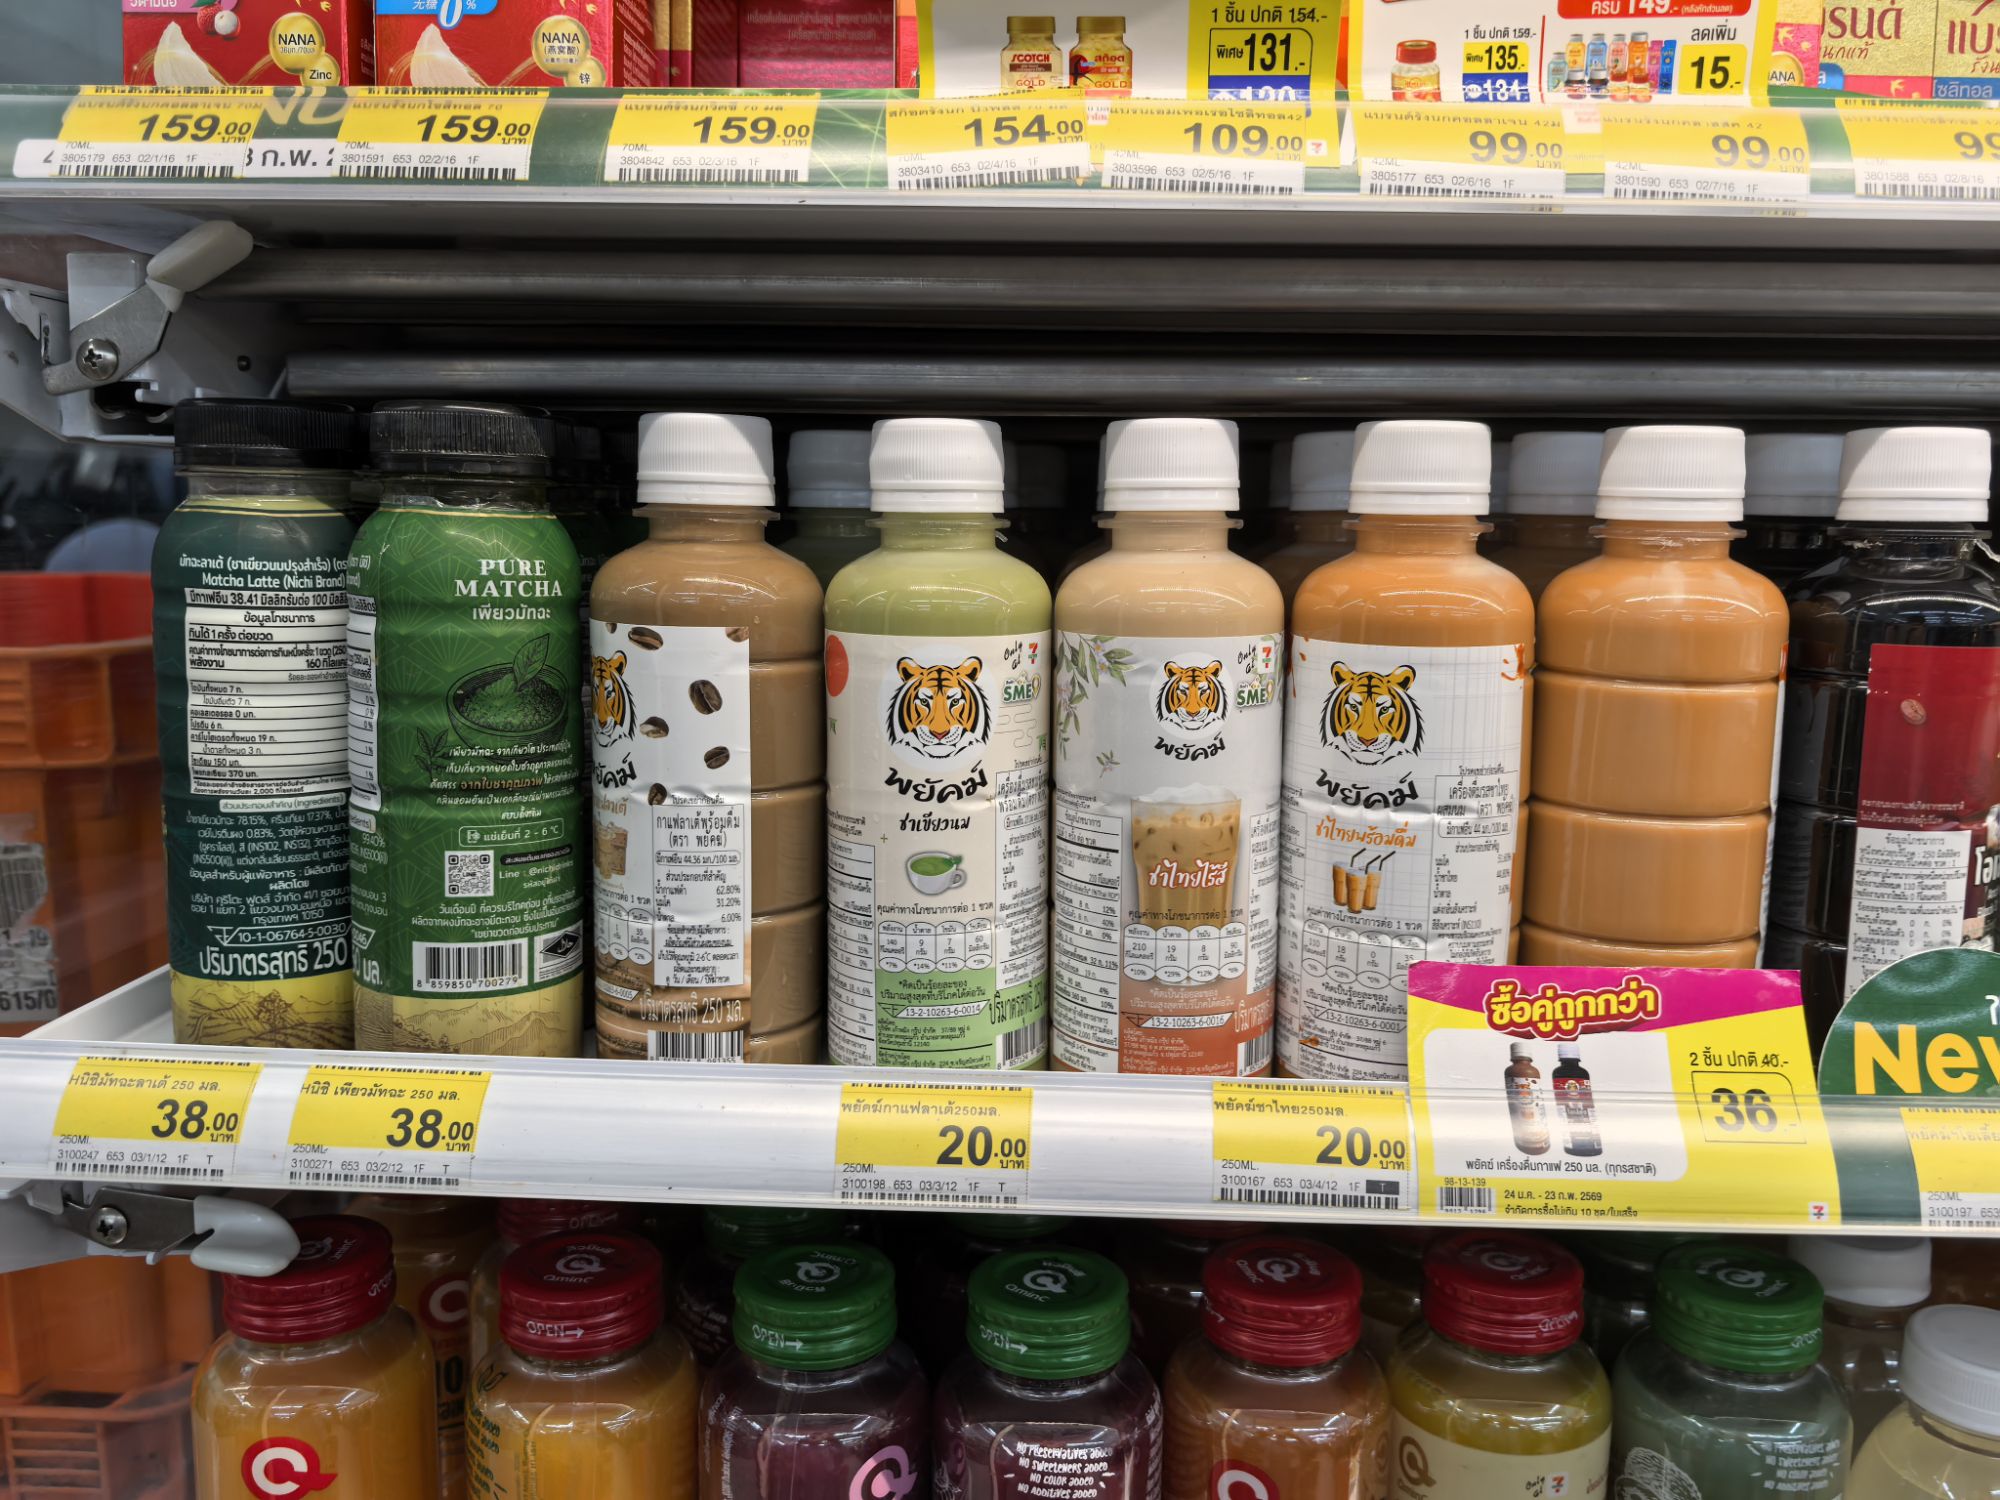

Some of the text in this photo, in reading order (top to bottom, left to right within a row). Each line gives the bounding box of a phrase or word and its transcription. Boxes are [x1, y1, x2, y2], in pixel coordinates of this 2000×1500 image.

[1225, 2, 1244, 23] ชิ้น
[1250, 5, 1282, 23] ปกติ
[1472, 25, 1510, 40] ชิ้น ปกติ
[1690, 19, 1737, 41] ลดเพิ่ม
[278, 34, 316, 46] NANA
[542, 33, 580, 44] NANA
[1011, 53, 1050, 62] SCOTCH
[1216, 44, 1243, 59] พิเศษ
[309, 70, 332, 80] Zinc
[1016, 79, 1045, 87] GOLD
[1094, 80, 1128, 88] GOLD
[138, 113, 252, 142] 159.00
[416, 115, 531, 143] 159.00
[693, 116, 810, 144] 159.00
[964, 113, 1083, 147] 154.00
[1183, 123, 1303, 157] 109.00
[1469, 131, 1563, 164] 99.00
[61, 154, 175, 163] 3805179 653 02/1/16
[261, 148, 317, 167] ก.พ.
[1711, 134, 1805, 168] 99.00
[341, 154, 456, 165] 3801591 653 02/2/16
[620, 156, 737, 166] 3804842 653 02/3/16
[898, 158, 1017, 177] 3803410 653 02/4/16
[1112, 163, 1231, 180] 3803596 653 02/5/16
[1371, 171, 1491, 188] 3805177 653 02/6/16
[1864, 170, 1984, 184] 3801588 653 02/8/16
[1615, 175, 1735, 192] 3801590 653 02/7/16
[479, 559, 547, 576] PURE
[202, 572, 346, 590] Matcha Latte (Nichi Brand)
[454, 579, 563, 598] MATCHA
[230, 592, 258, 605] 38.41
[312, 593, 328, 606] 100
[243, 610, 316, 626] ข้อมูลโภชนาการ
[472, 603, 552, 620] เพียวมัทฉะ
[218, 625, 237, 640] ครั้ง
[306, 658, 321, 669] 160
[1003, 686, 1033, 702] SME
[1236, 687, 1267, 706] SME
[1154, 731, 1226, 762] พยัคฆ์
[213, 756, 228, 767] 150
[228, 766, 244, 777] 370
[884, 760, 988, 804] พยัคฆ์
[1315, 768, 1419, 810] พยัคฆ์
[656, 806, 740, 831] กาแฟลาเต้พร้อมดื่ม
[899, 811, 971, 832] ชาเขียวนม
[484, 826, 548, 842] แช่เย็นที่ 2 6
[1315, 815, 1417, 847] ชาไทยพร้อมดื่ม
[669, 833, 689, 848] (ตรา
[683, 855, 701, 865] 44.36
[499, 869, 520, 879] Line
[1149, 858, 1229, 889] ชาไทยไร้สี
[269, 879, 310, 891] ผลิตโดย
[716, 885, 741, 895] 62.80%
[716, 898, 741, 908] 31.20%
[877, 903, 969, 916] คุณค่าทางโภชนาการต่อ
[721, 913, 742, 923] 6.00%
[238, 922, 346, 943] 10-1-06764-5-0030
[1132, 942, 1177, 954] 210 19
[199, 937, 348, 979] ปริมาตรสุทธิ 250
[430, 977, 519, 989] 859850 700279
[640, 991, 699, 1033] ปริมาตรสุทธิ
[701, 997, 723, 1024] 250
[726, 996, 745, 1023] มล.
[1489, 980, 1655, 1033] ซื้อคู่ถูกกว่า
[1325, 1011, 1400, 1032] 13-2-10263-6-0001
[1689, 1047, 1758, 1068] 2 ชิ้น ปกติ
[171, 1080, 194, 1091] 250
[334, 1082, 406, 1099] เพียวมัทฉะ
[410, 1089, 433, 1100] 250
[151, 1098, 239, 1139] 38.00
[386, 1107, 475, 1149] 38.00
[210, 1132, 234, 1143] บาท
[936, 1124, 1027, 1166] 20.00
[446, 1141, 470, 1152] บาท
[1316, 1125, 1406, 1167] 20.00
[57, 1149, 168, 1163] 3100247 653 03/1/12
[999, 1158, 1025, 1169] บาท
[290, 1158, 403, 1173] 3100271 653 03/2/12
[1221, 1158, 1260, 1171] 250ML.
[1379, 1159, 1405, 1170] บาท
[1466, 1155, 1657, 1178] พยัคฆ์ เครื่องดื่มกาแฟ 250 (ทุกรสชาติ)
[842, 1179, 957, 1192] 3100198 653 03/3/12
[1221, 1174, 1338, 1190] 3100167 653 03/4/12
[1444, 1177, 1486, 1187] 98-13-139
[1504, 1190, 1602, 1201] 24 23 2569
[1928, 1207, 1972, 1218] 3100197
[526, 1320, 565, 1338] OPEN
[751, 1323, 786, 1348] OPEN
[979, 1324, 1011, 1351] OPEN
[1018, 1456, 1030, 1469] NO
[1029, 1472, 1041, 1483] NO
[1017, 1482, 1030, 1493] NO
